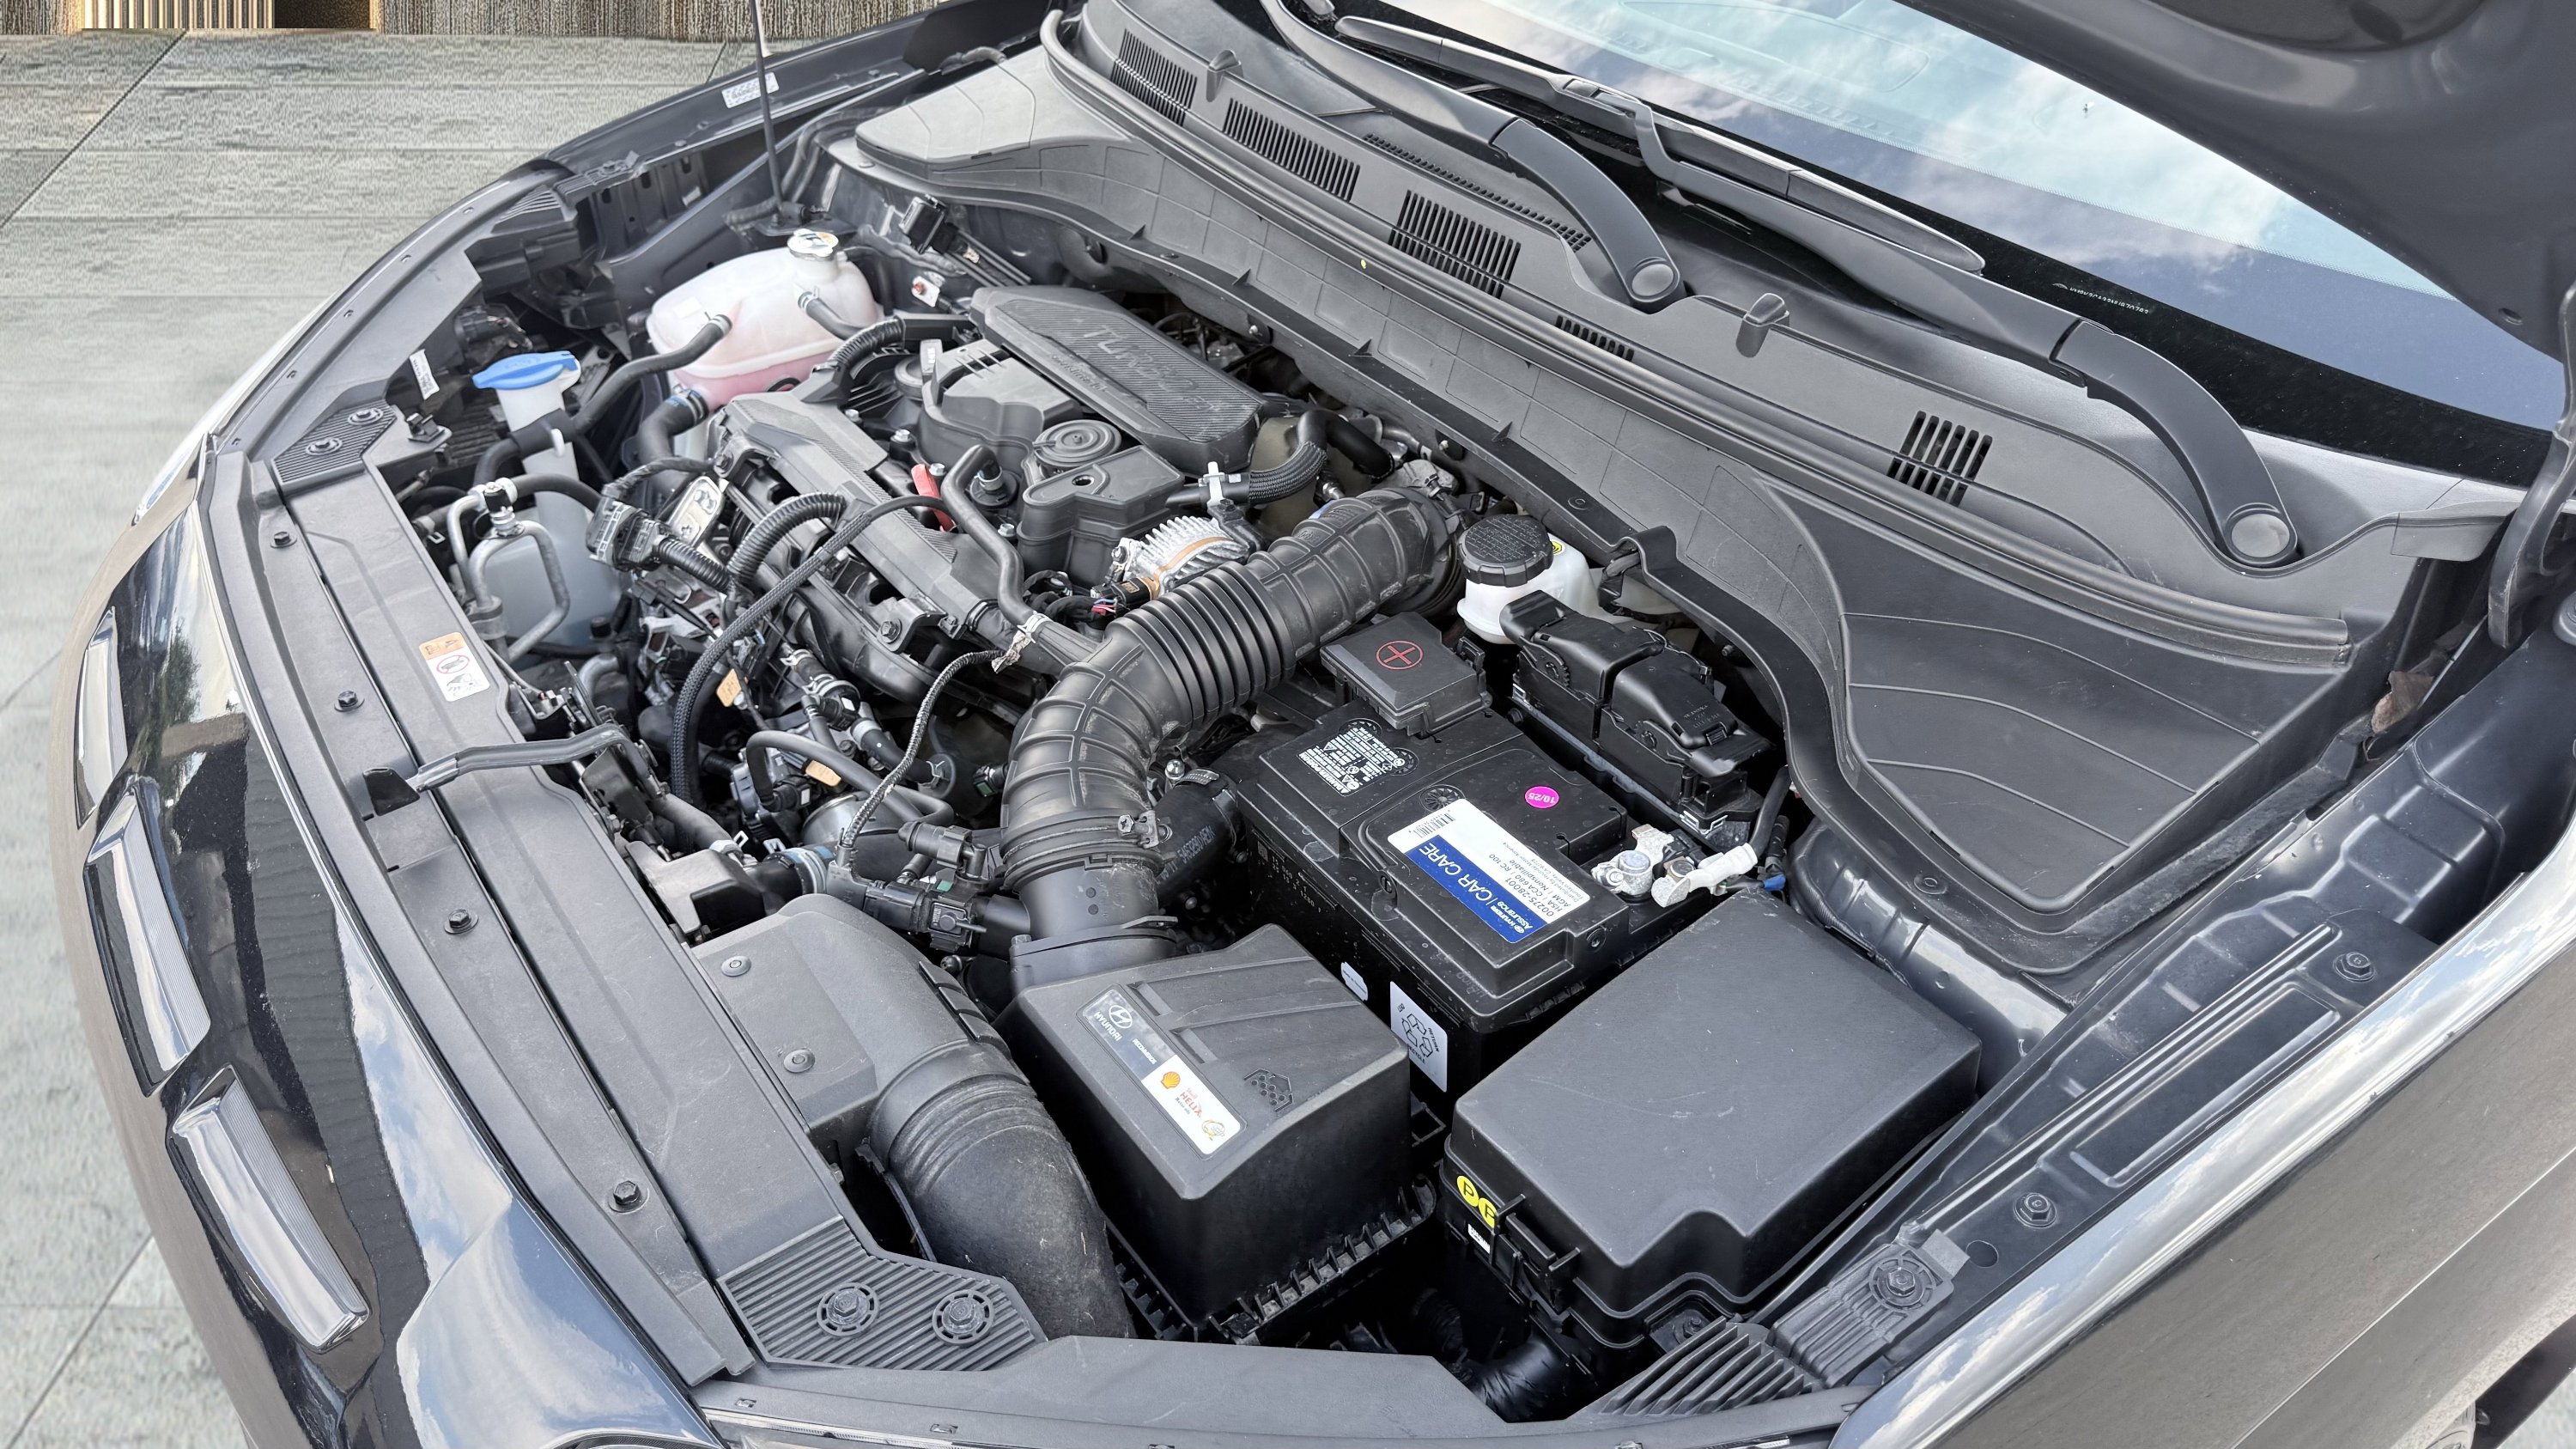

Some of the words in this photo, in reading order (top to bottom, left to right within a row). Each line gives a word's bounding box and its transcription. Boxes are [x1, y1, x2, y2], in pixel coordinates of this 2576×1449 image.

[1083, 325, 1200, 393] TURBO
[1419, 843, 1461, 875] CARE
[1489, 854, 1501, 864] 100
[1499, 862, 1511, 872] RC
[1457, 874, 1492, 901] CAR
[1510, 859, 1548, 892] Nonspillable
[1515, 874, 1529, 886] 680
[1505, 877, 1554, 917] 00275-28001
[1528, 885, 1543, 897] CCA
[1552, 894, 1571, 907] AGM
[1490, 904, 1515, 927] HYUNDAI
[1497, 901, 1533, 929] Assurance
[1547, 899, 1563, 912] H5A
[1093, 1011, 1123, 1042] HYUNDAI
[1428, 1027, 1440, 1052] RETURN
[1180, 1092, 1202, 1117] HELIX
[1463, 1180, 1474, 1197] P
